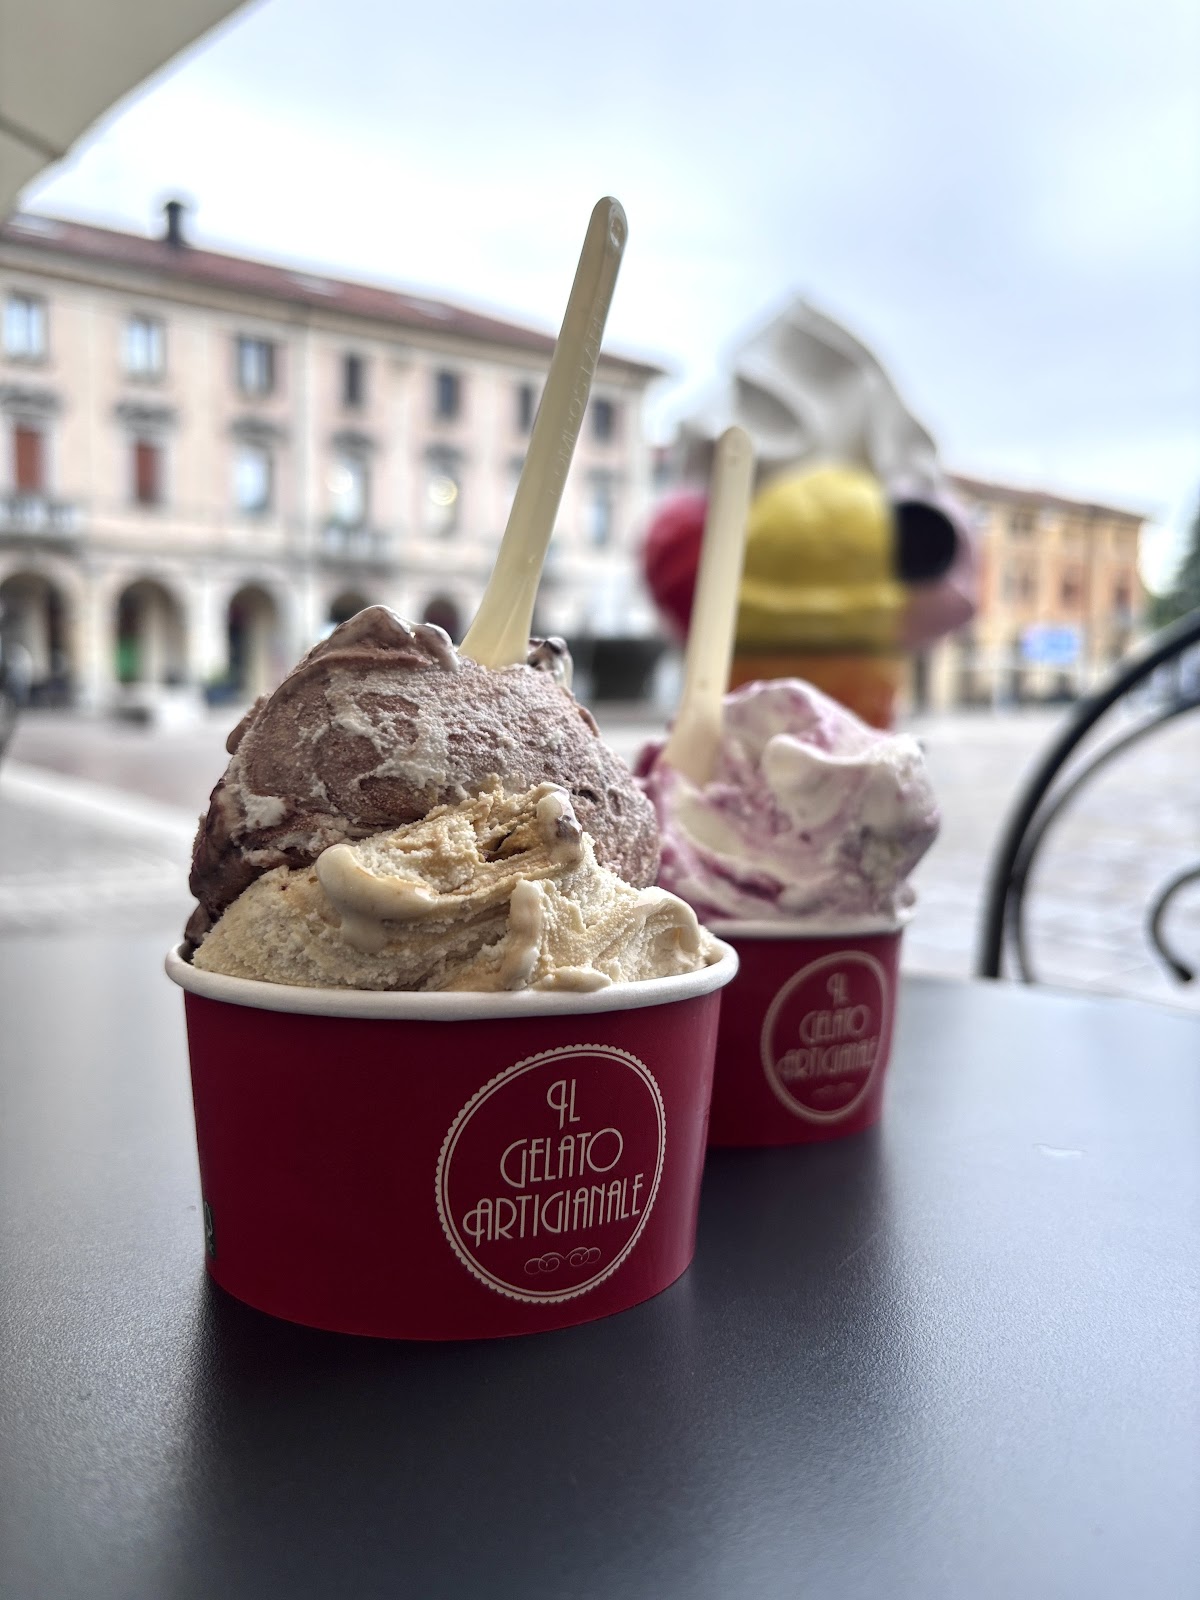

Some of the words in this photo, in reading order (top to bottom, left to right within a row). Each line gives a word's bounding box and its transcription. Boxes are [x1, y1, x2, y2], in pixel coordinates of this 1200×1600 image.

[546, 1078, 580, 1130] IL
[500, 1127, 624, 1188] GELATO
[462, 1173, 644, 1248] ARTIGIANALE
